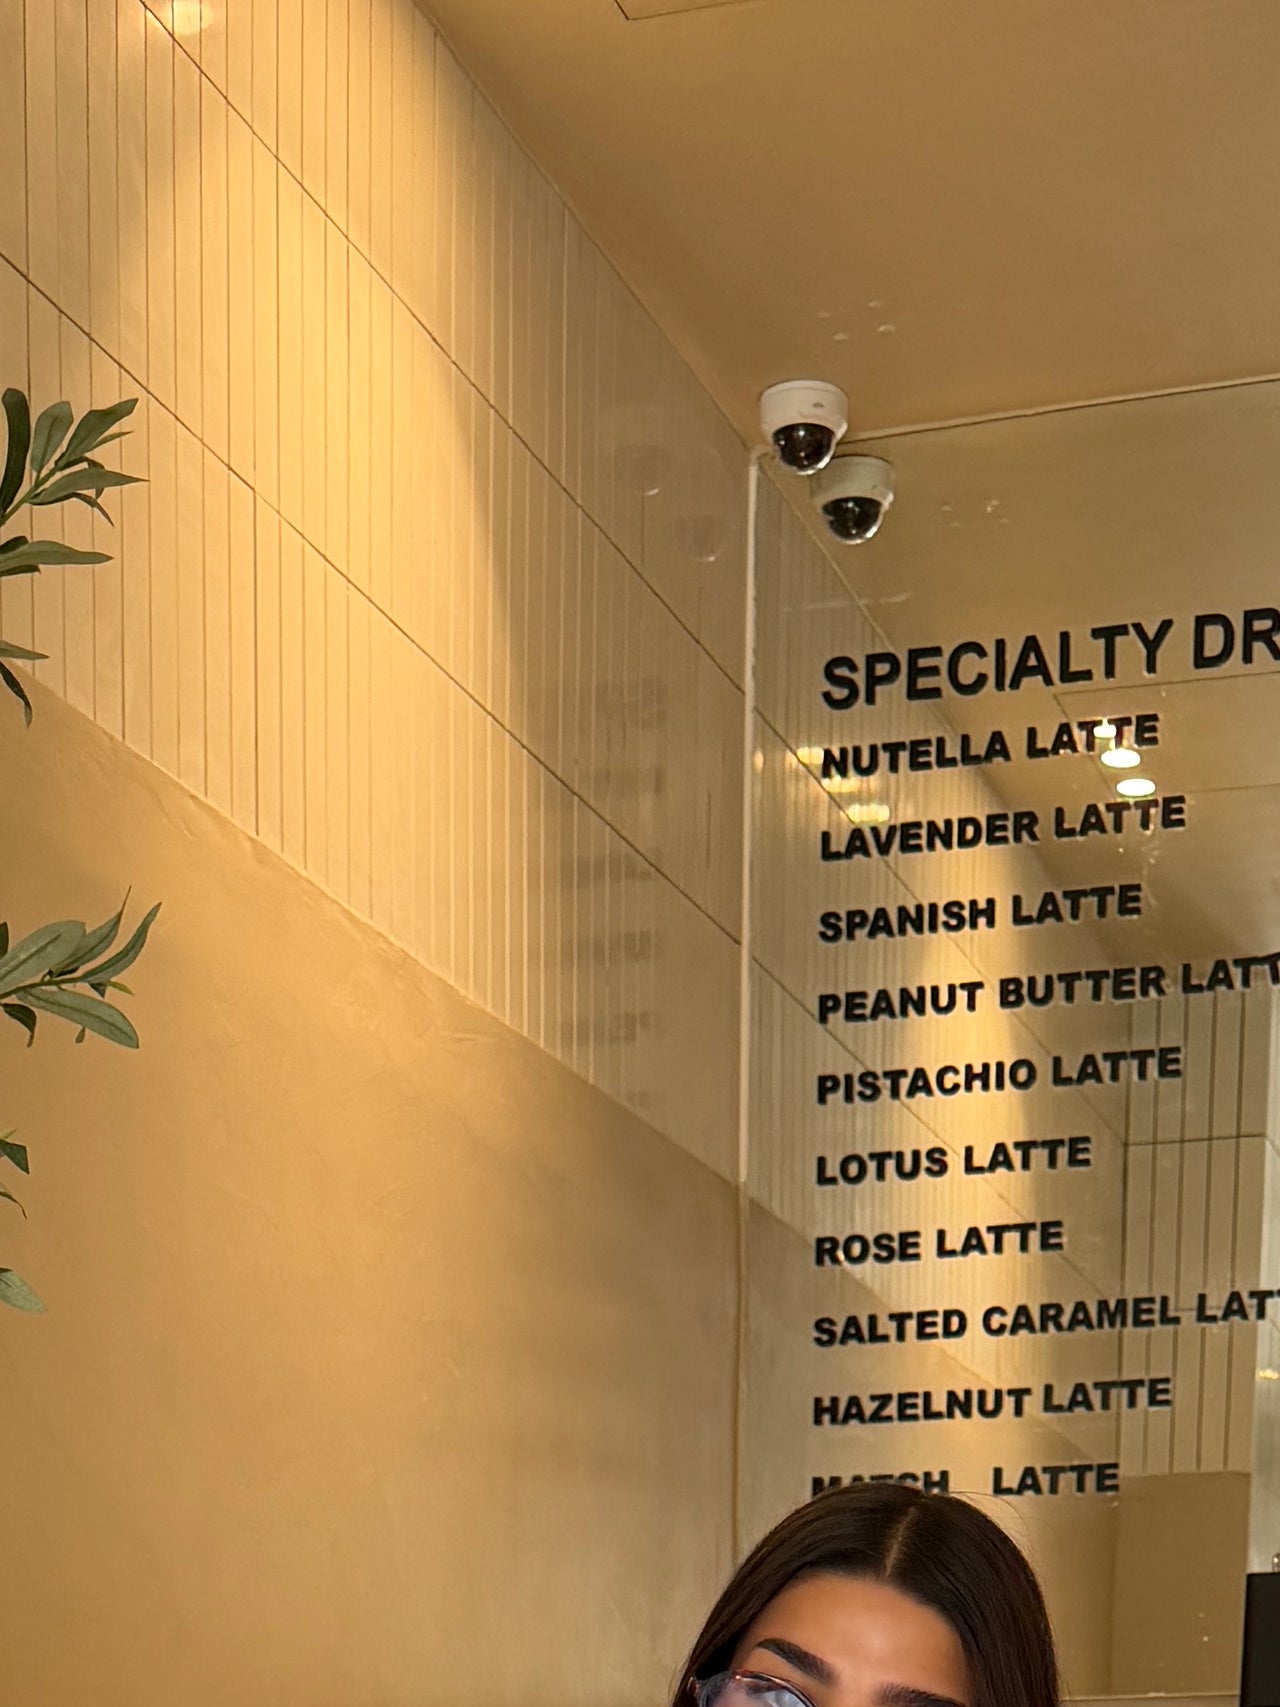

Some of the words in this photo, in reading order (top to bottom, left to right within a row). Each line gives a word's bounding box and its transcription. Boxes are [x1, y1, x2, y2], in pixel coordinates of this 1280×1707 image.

[821, 618, 1174, 710] SPECIALTY
[821, 730, 1012, 780] NUTELLA
[1026, 713, 1160, 760] LATTE
[821, 810, 1040, 862] LAVENDER
[1054, 795, 1187, 840] LATTE
[818, 897, 996, 943] SPANISH
[1011, 883, 1143, 926] LATTE
[818, 979, 985, 1024] PEANUT
[999, 964, 1166, 1010] BUTTER
[817, 1058, 1037, 1104] PISTACHIO
[1052, 1046, 1183, 1089] LATTE
[816, 1145, 950, 1187] LOTUS
[963, 1135, 1092, 1176] LATTE
[815, 1229, 922, 1267] ROSE
[935, 1220, 1065, 1259] LATTE
[813, 1307, 968, 1348] SALTED
[981, 1294, 1181, 1338] CARAMEL
[812, 1386, 1032, 1428] HAZELNUT
[1042, 1376, 1172, 1415] LATTE
[992, 1462, 1119, 1496] LATTE
